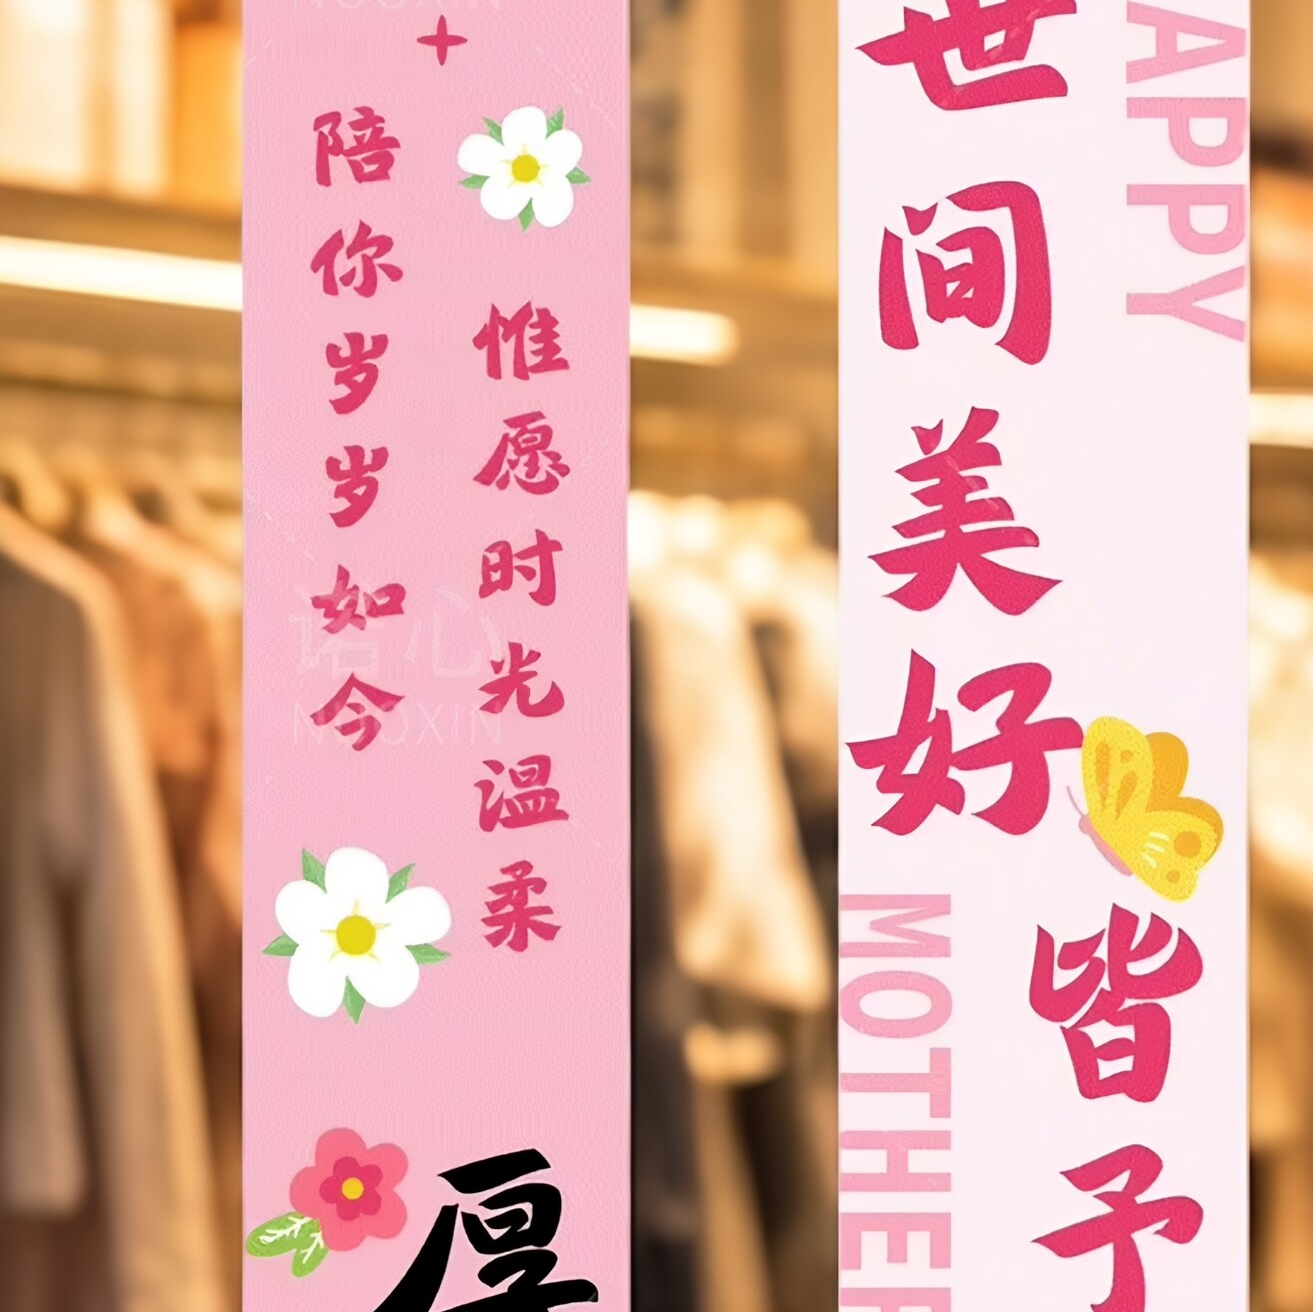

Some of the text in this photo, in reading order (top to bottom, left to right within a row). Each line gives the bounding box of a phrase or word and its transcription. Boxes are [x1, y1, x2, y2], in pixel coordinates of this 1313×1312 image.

[310, 105, 407, 753] 陪你岁岁如今
[472, 300, 572, 953] 惟愿时光温柔
